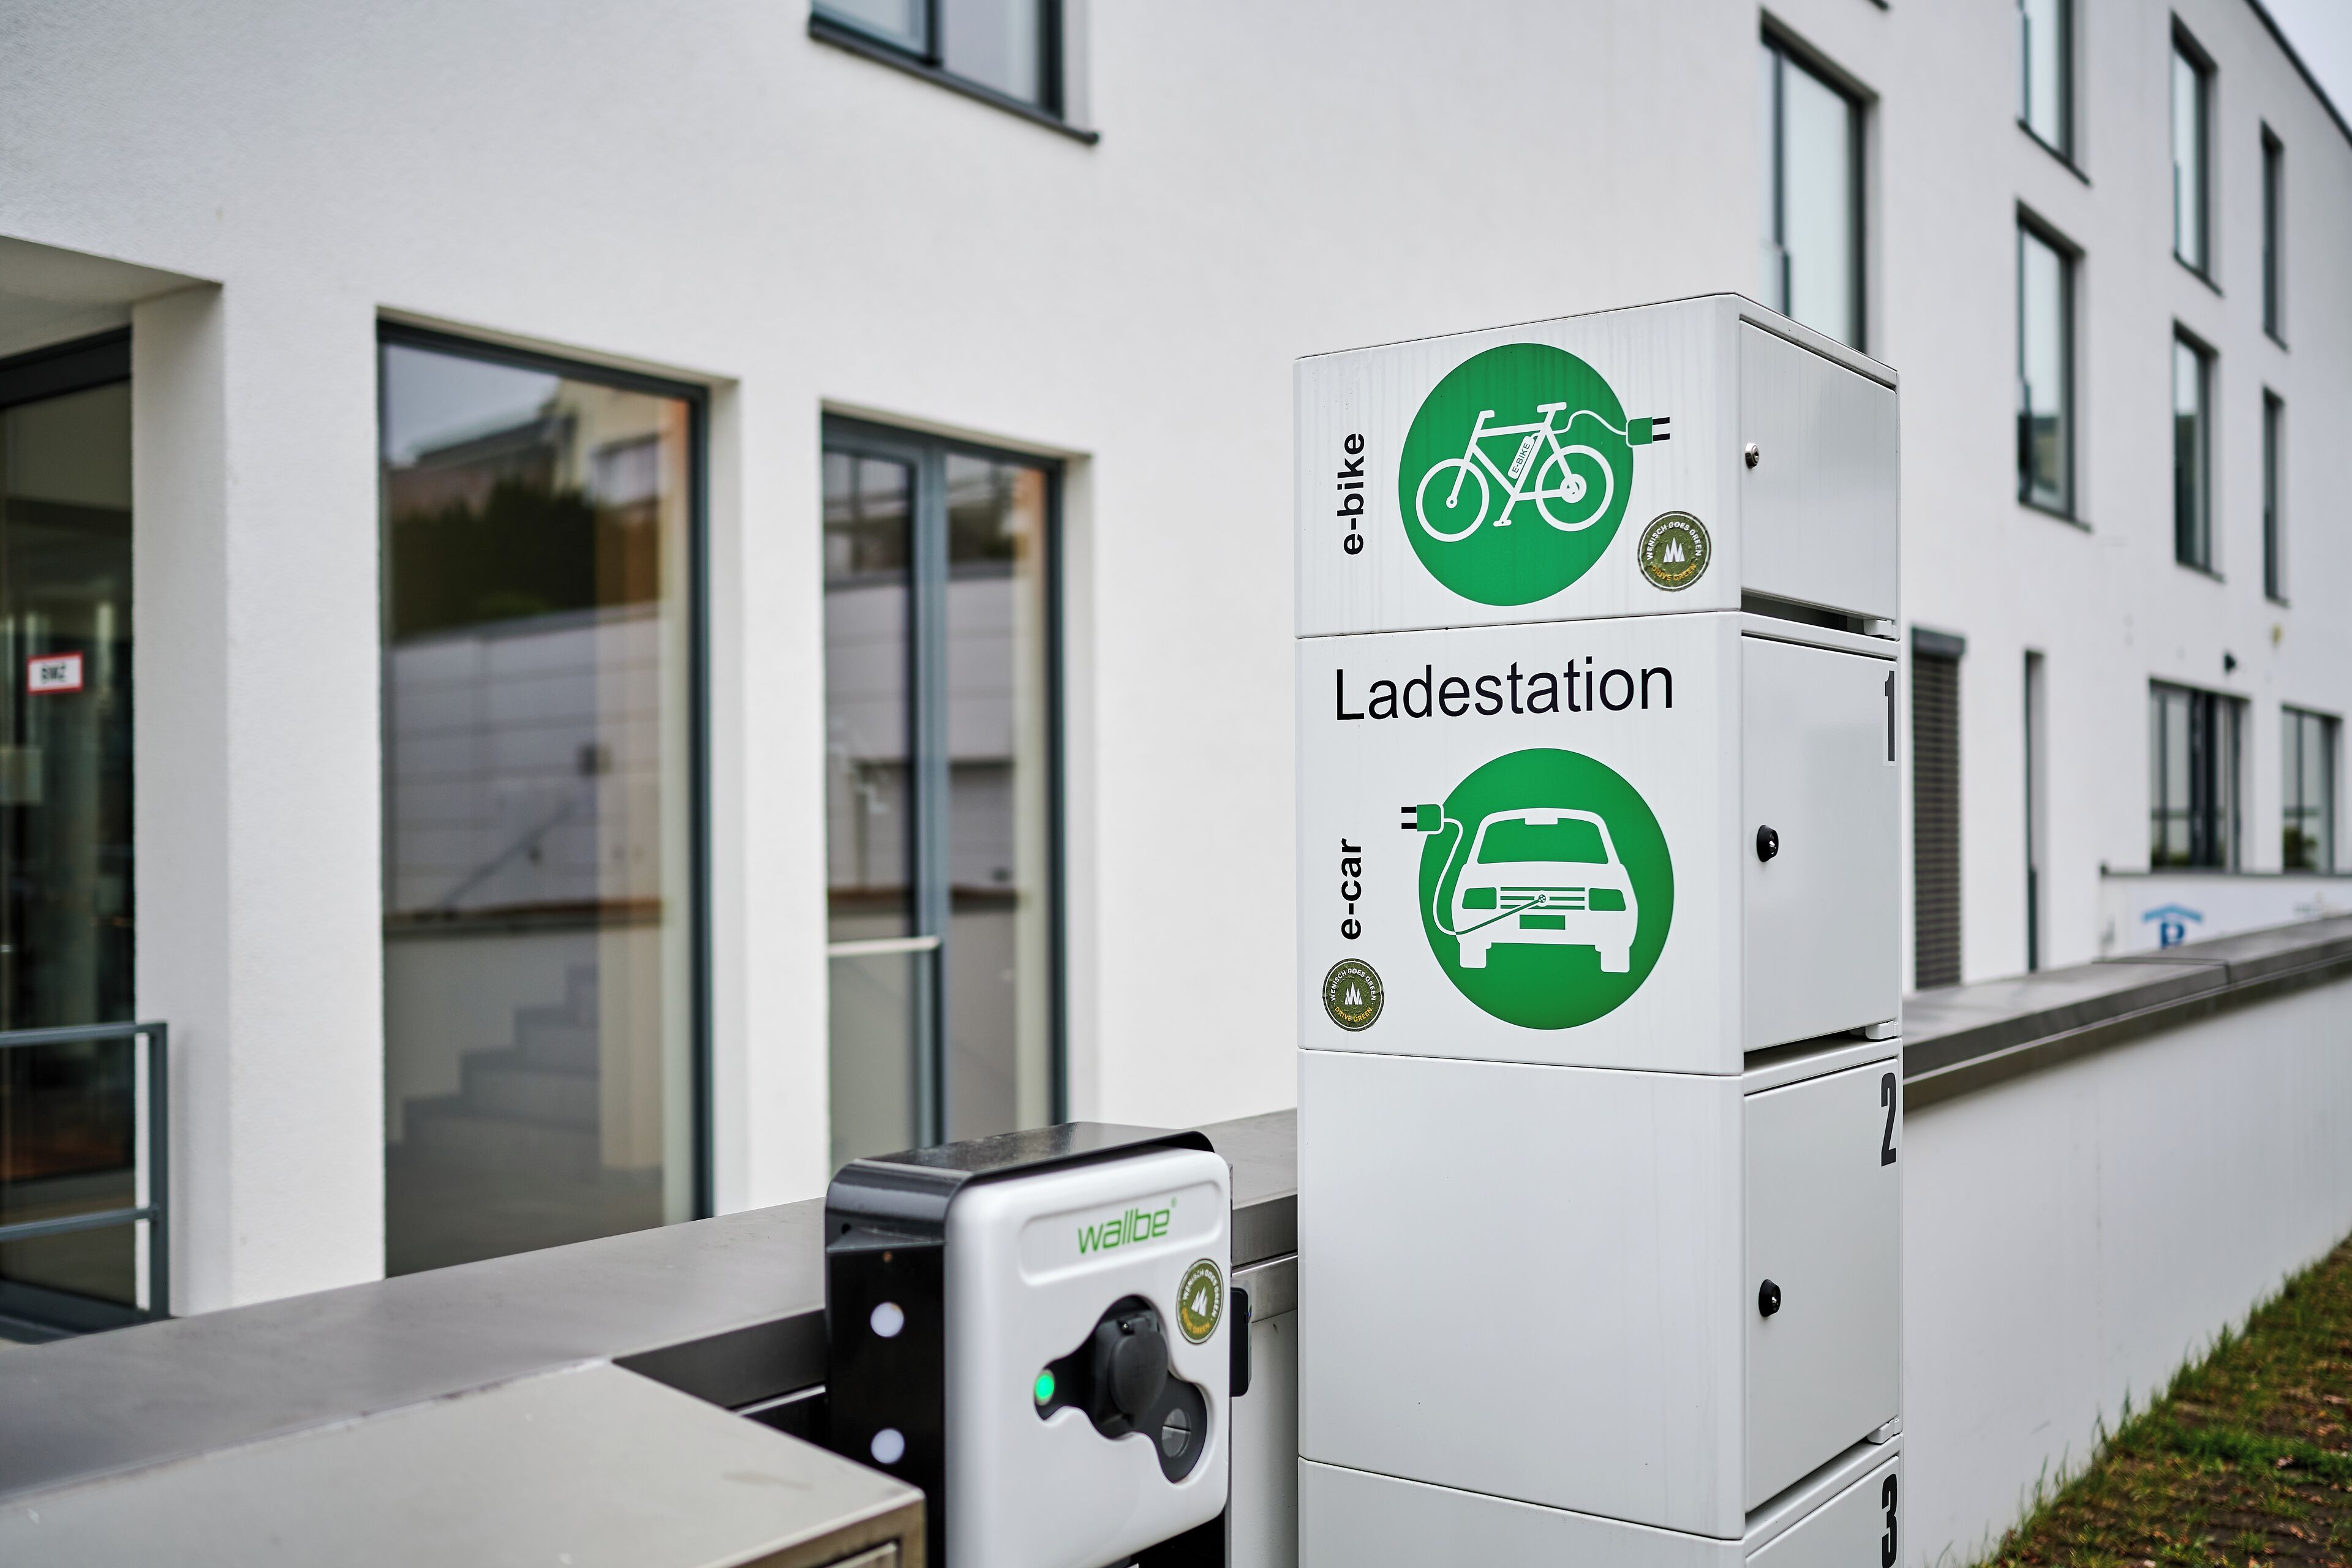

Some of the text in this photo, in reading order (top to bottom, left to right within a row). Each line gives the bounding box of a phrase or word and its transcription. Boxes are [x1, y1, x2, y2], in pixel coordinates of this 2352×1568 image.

[1512, 442, 1531, 473] E-BIKE
[1337, 433, 1365, 555] e-bike
[1646, 521, 1702, 560] WENISCH GOES GREEN
[1651, 563, 1697, 581] DRIVE GREEN
[1336, 655, 1673, 720] Ladestation
[1884, 670, 1895, 761] 1
[1341, 837, 1362, 940] e-car
[1330, 968, 1376, 1001] WENISCH GOES GREEN
[1335, 1006, 1373, 1022] DRIVE GREEN
[1881, 1072, 1896, 1167] 2
[1077, 1208, 1170, 1254] wallbe
[1882, 1473, 1898, 1568] 3
